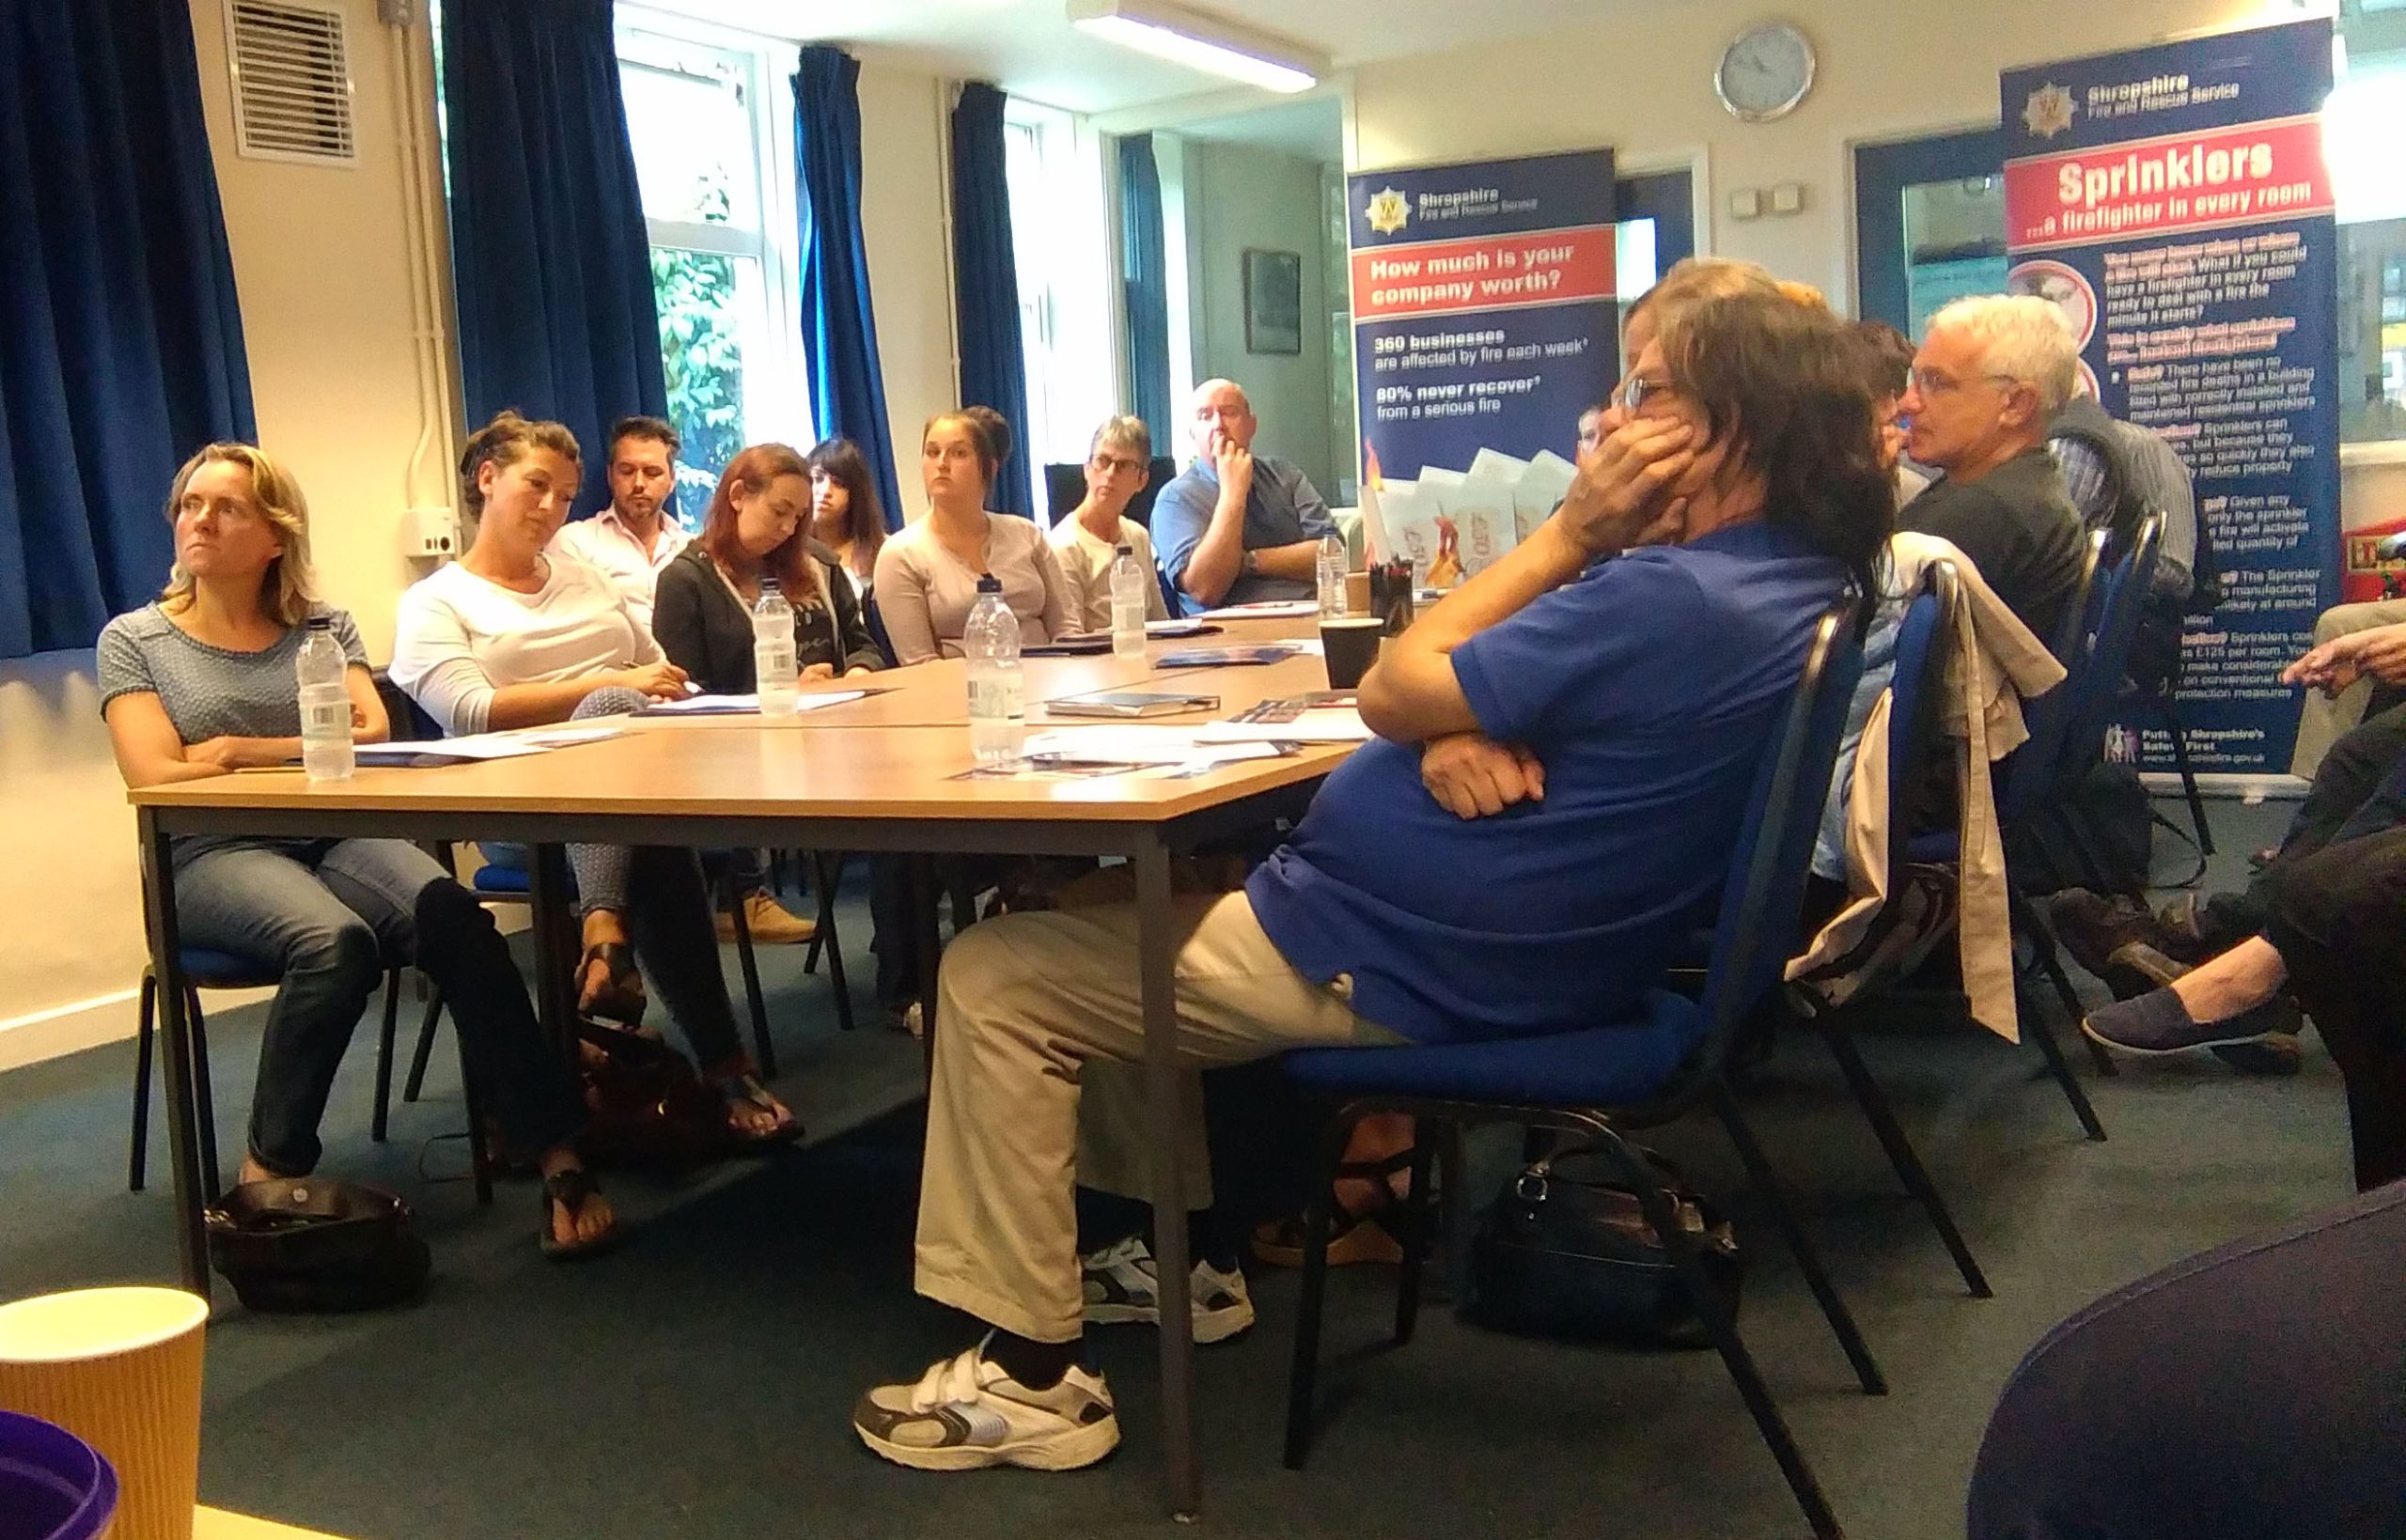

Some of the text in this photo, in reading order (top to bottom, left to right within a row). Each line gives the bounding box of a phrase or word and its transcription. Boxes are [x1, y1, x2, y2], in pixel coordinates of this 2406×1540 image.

[2088, 73, 2189, 104] Shropshire
[2058, 142, 2273, 210] Sprinklers
[1419, 188, 1499, 207] Shropshire
[2063, 202, 2162, 234] firefighter
[2169, 196, 2188, 219] in
[2195, 189, 2252, 216] every
[2258, 181, 2311, 208] room
[1370, 245, 1574, 280] How much is your
[1371, 269, 1562, 306] company worth?
[1374, 329, 1505, 354] 360 businesses
[1374, 355, 1398, 372] are
[1401, 350, 1457, 369] affected
[1460, 349, 1476, 367] by
[1480, 345, 1503, 363] fire
[1507, 342, 1541, 360] each
[1417, 382, 1464, 401] never
[1376, 397, 1501, 422] from a serious fire
